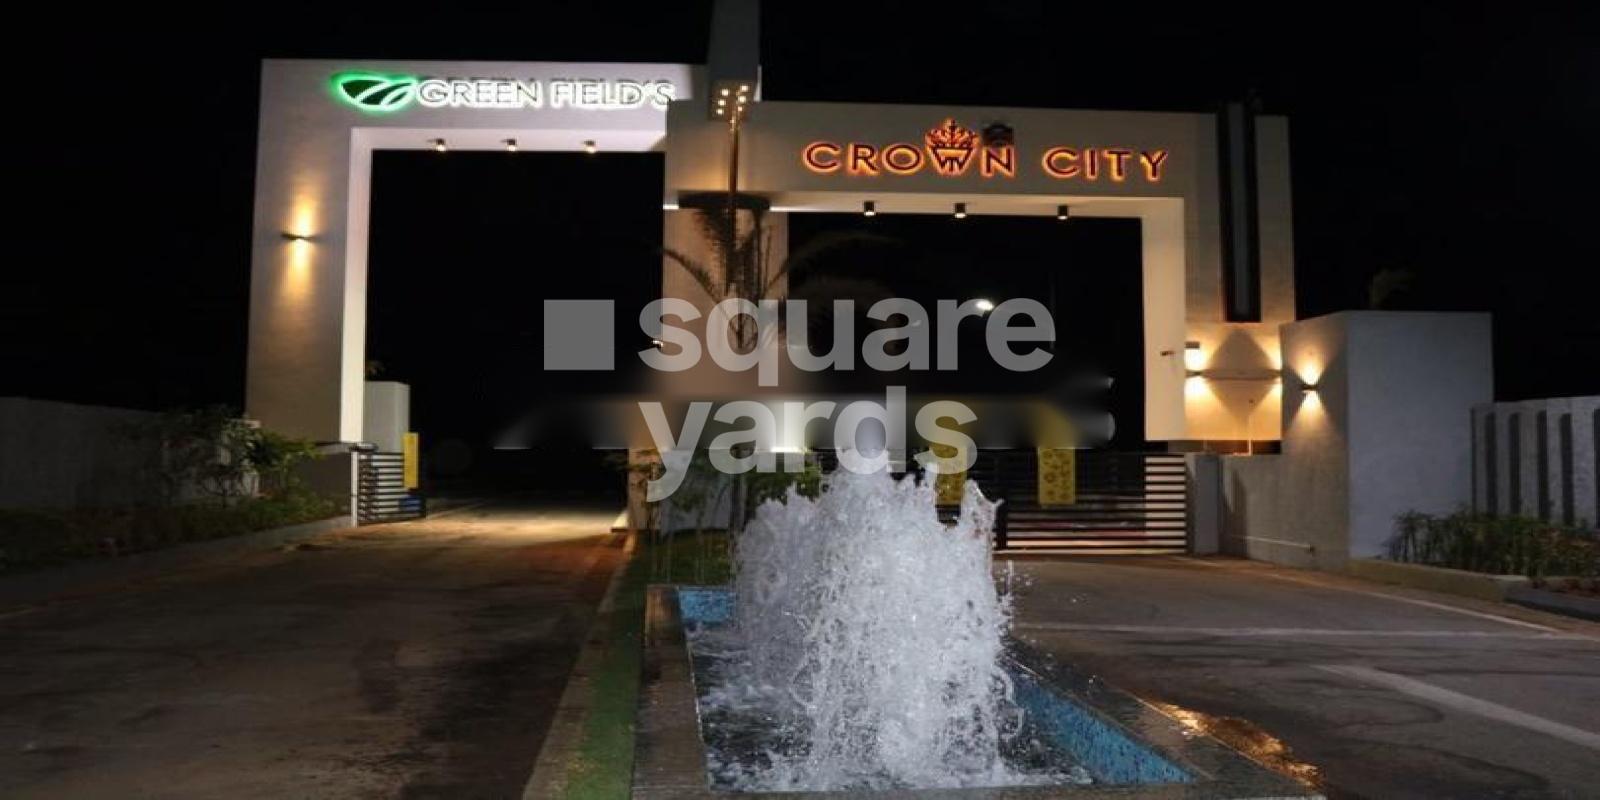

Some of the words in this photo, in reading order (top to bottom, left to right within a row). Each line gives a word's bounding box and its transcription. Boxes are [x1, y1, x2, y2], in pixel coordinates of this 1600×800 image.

[417, 79, 542, 108] GREEN
[550, 80, 676, 109] FIELD'S
[803, 130, 1016, 177] CROWN
[1042, 146, 1169, 180] CITY
